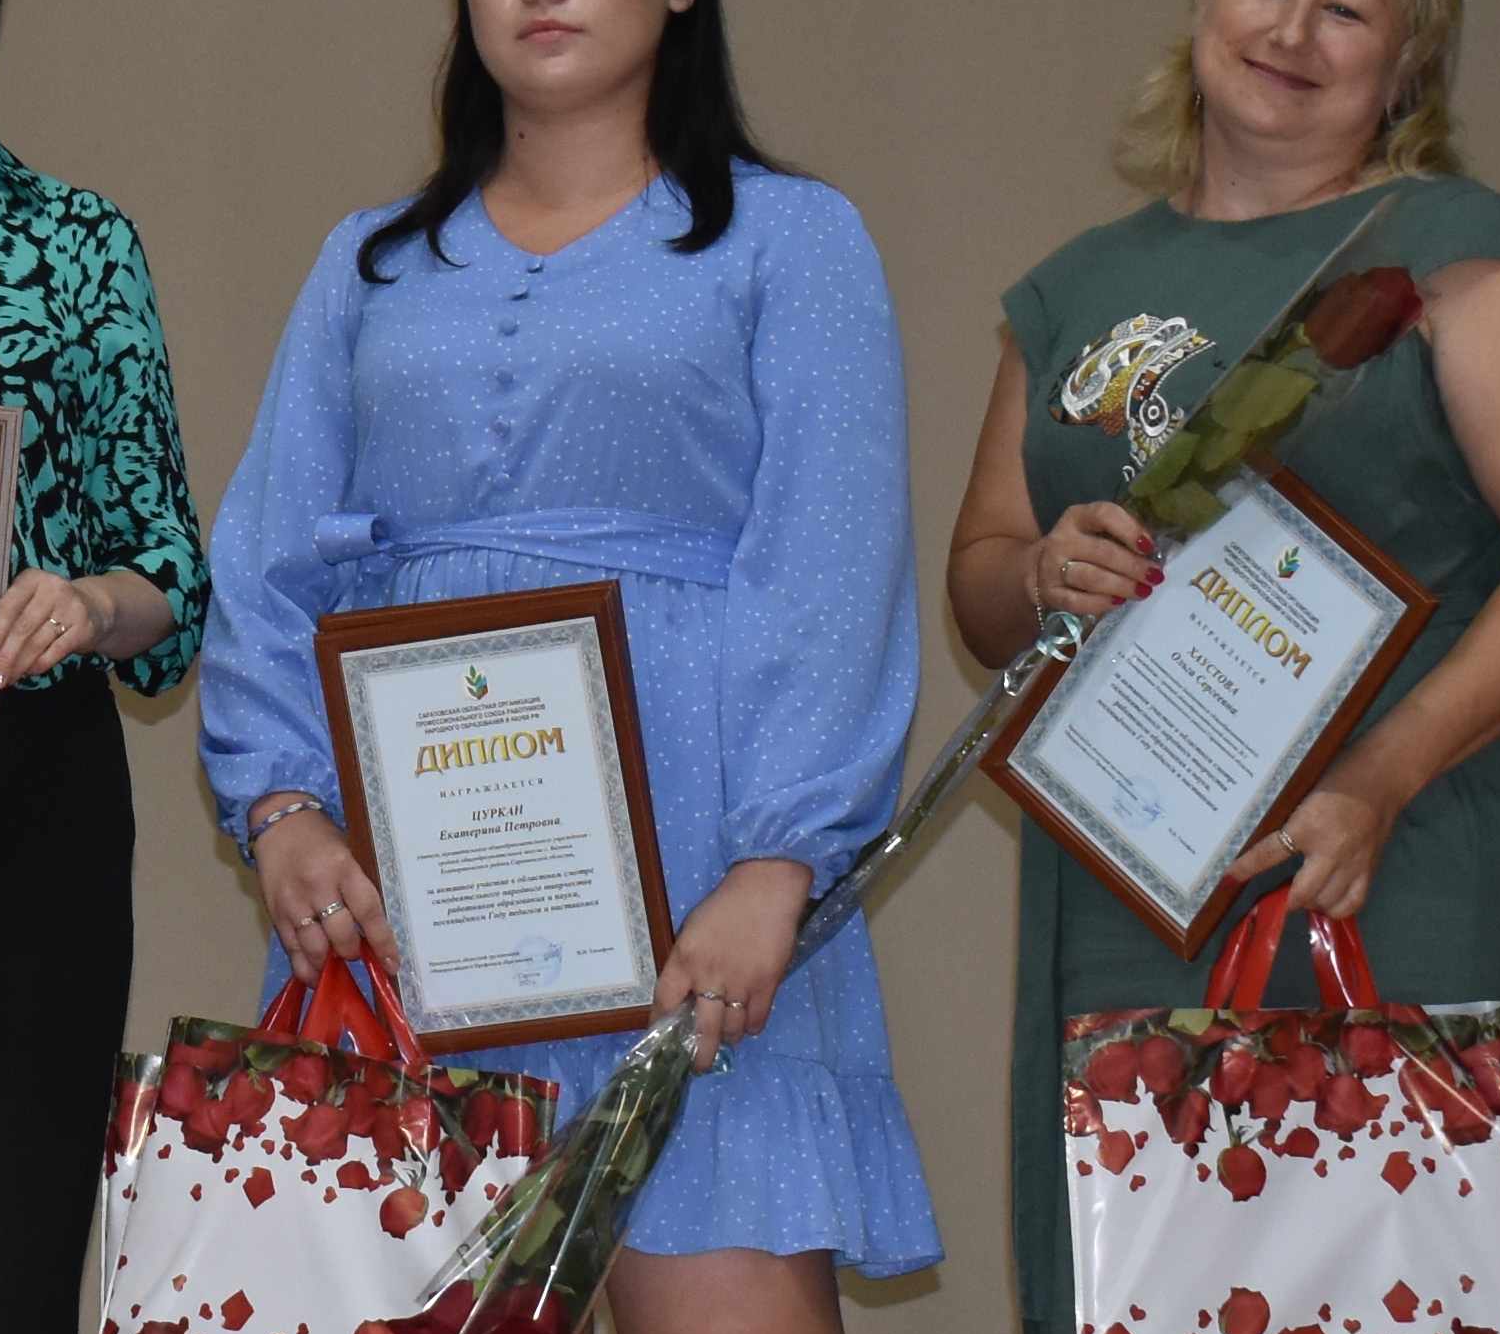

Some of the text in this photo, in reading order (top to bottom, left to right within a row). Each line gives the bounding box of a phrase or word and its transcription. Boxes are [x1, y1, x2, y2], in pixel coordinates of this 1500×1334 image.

[1189, 565, 1313, 680] ДИПЛОМ
[1169, 649, 1240, 717] Ольга Сергеевна
[1187, 646, 1240, 696] ХАУСТОВА
[414, 726, 567, 777] ДИПЛОМ
[439, 777, 543, 798] НАГРАЖДАЕТСЯ
[471, 804, 524, 821] ЦУРКАН
[438, 814, 561, 842] Екатерина Петровна
